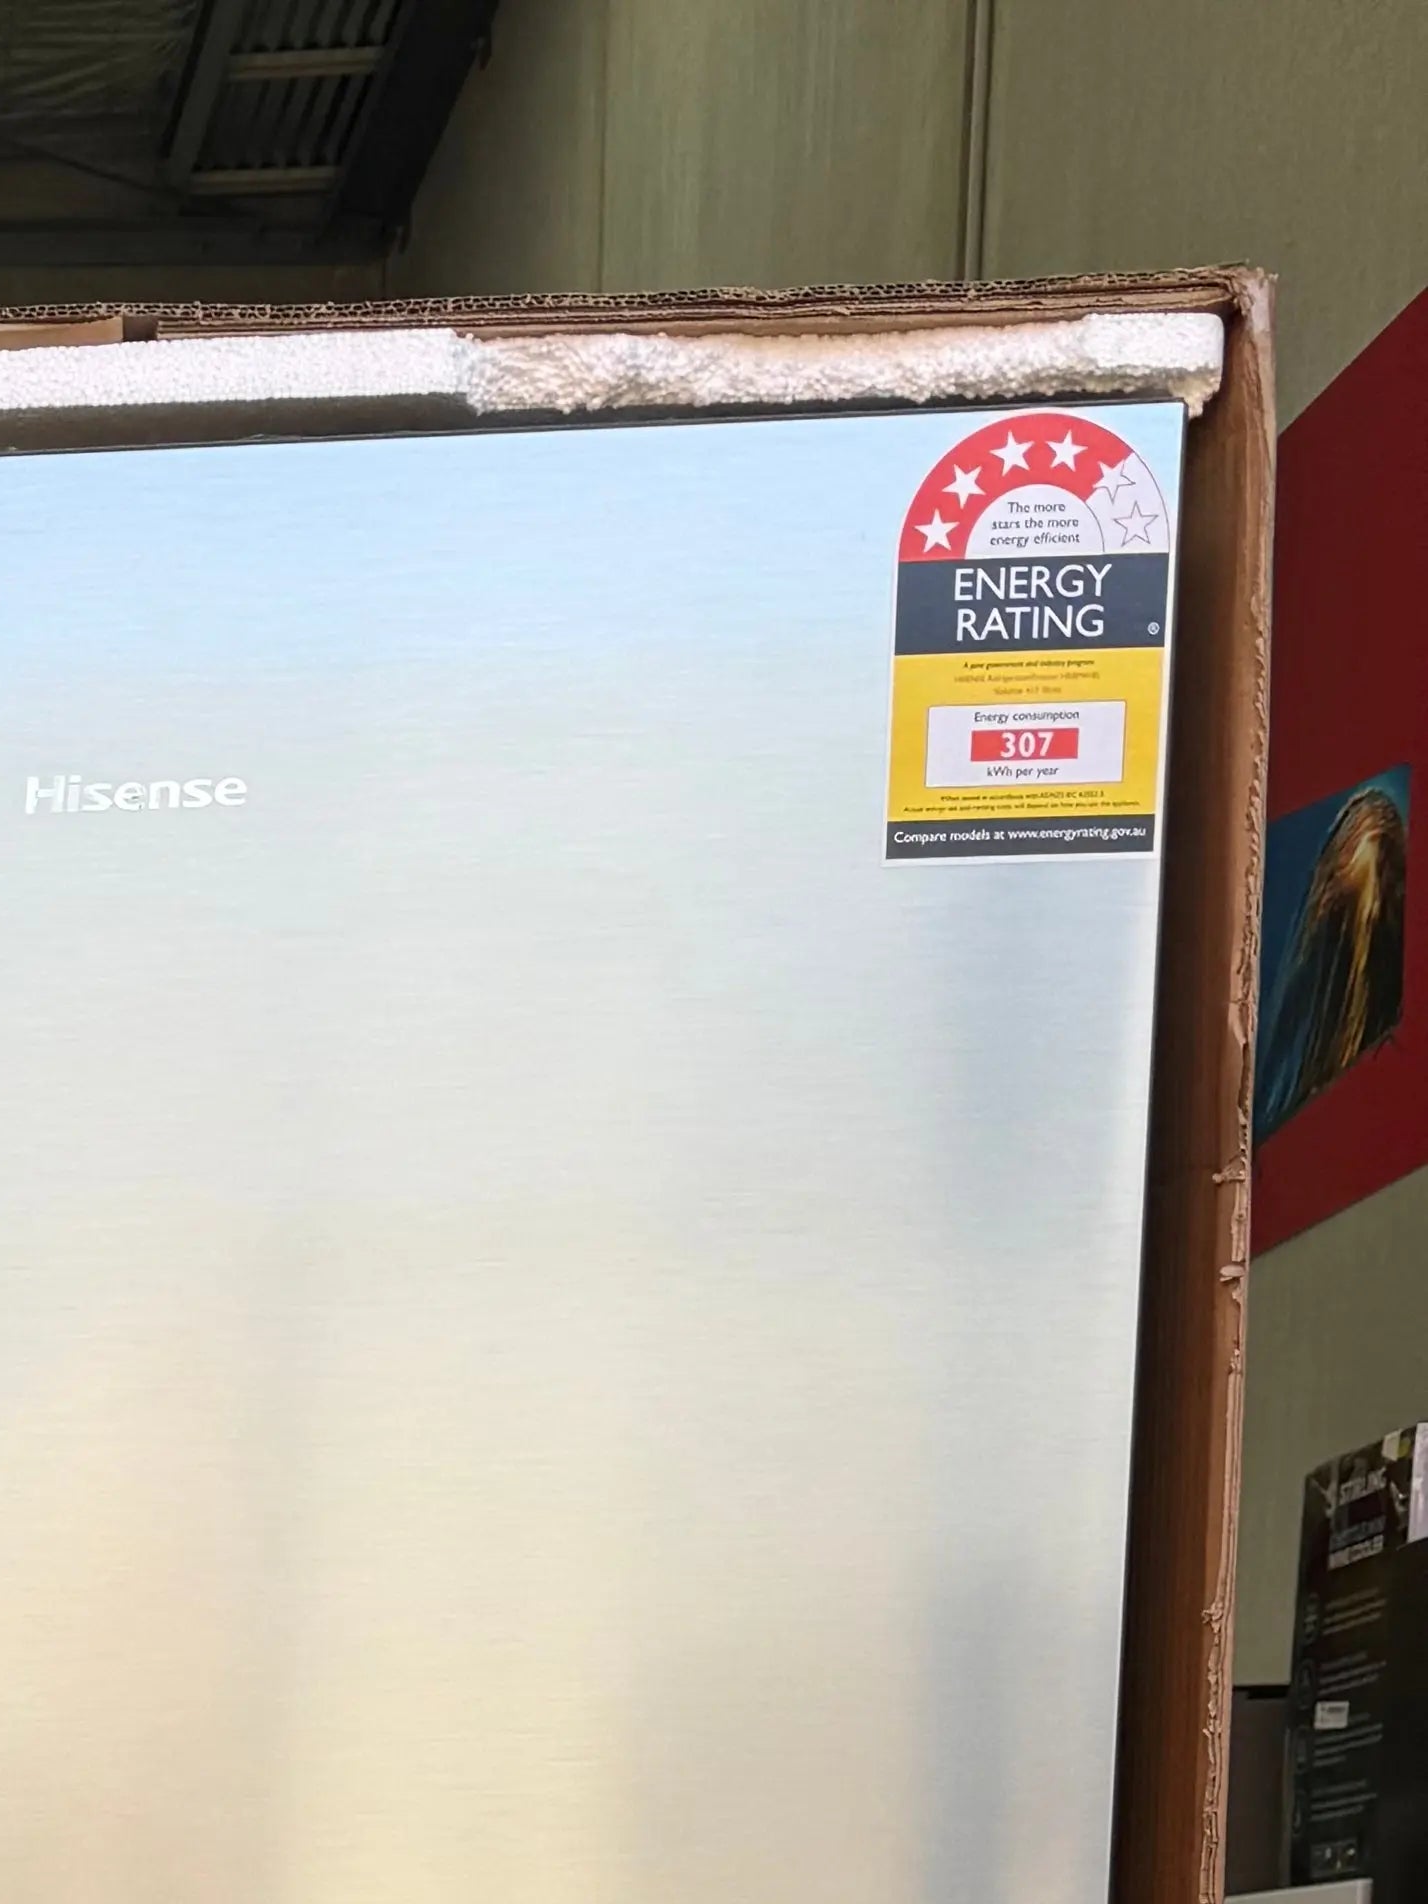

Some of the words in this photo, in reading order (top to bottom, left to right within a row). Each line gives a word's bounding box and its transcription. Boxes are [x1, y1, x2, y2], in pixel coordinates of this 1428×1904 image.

[1007, 501, 1030, 513] The
[1034, 503, 1066, 513] more
[991, 520, 1021, 530] stars
[1024, 517, 1044, 529] the
[1047, 518, 1079, 528] more
[990, 536, 1029, 548] energy
[1033, 532, 1080, 544] efficient
[954, 563, 1112, 601] ENERGY
[956, 604, 1104, 642] RATING
[974, 712, 1009, 724] Energy
[1012, 710, 1080, 724] consumption
[1000, 731, 1054, 758] 307
[987, 766, 1012, 777] kWh
[1016, 767, 1033, 779] per
[1037, 767, 1059, 778] year
[24, 775, 248, 815] Hisense
[894, 831, 947, 845] Compare
[950, 828, 991, 841] models
[993, 831, 1005, 840] at
[1008, 827, 1146, 842] www.energyrating.gov.au
